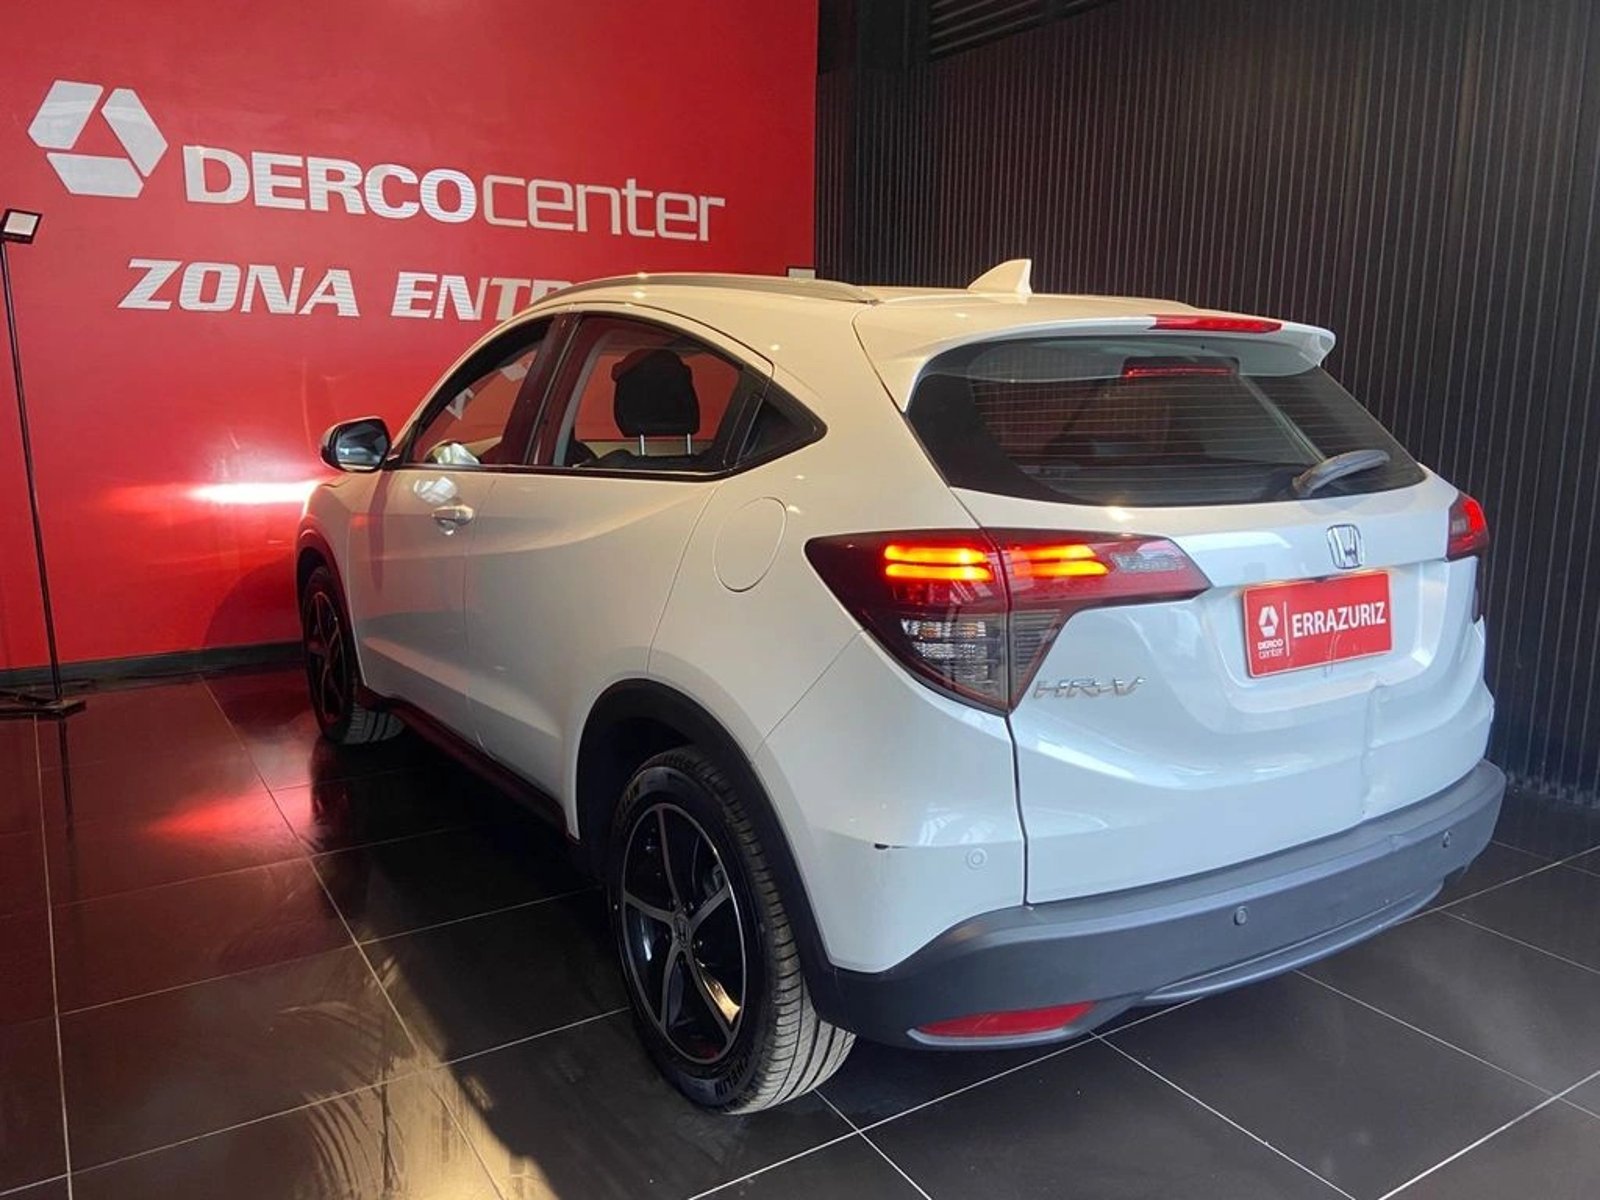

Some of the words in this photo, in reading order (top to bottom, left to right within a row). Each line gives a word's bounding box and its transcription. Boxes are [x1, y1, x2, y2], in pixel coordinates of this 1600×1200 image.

[182, 144, 725, 242] DERCOcenter
[117, 258, 361, 318] ZONA
[1291, 601, 1387, 638] ERRAZURIZ
[1257, 638, 1284, 651] DERCO
[1033, 676, 1146, 699] HR-V
